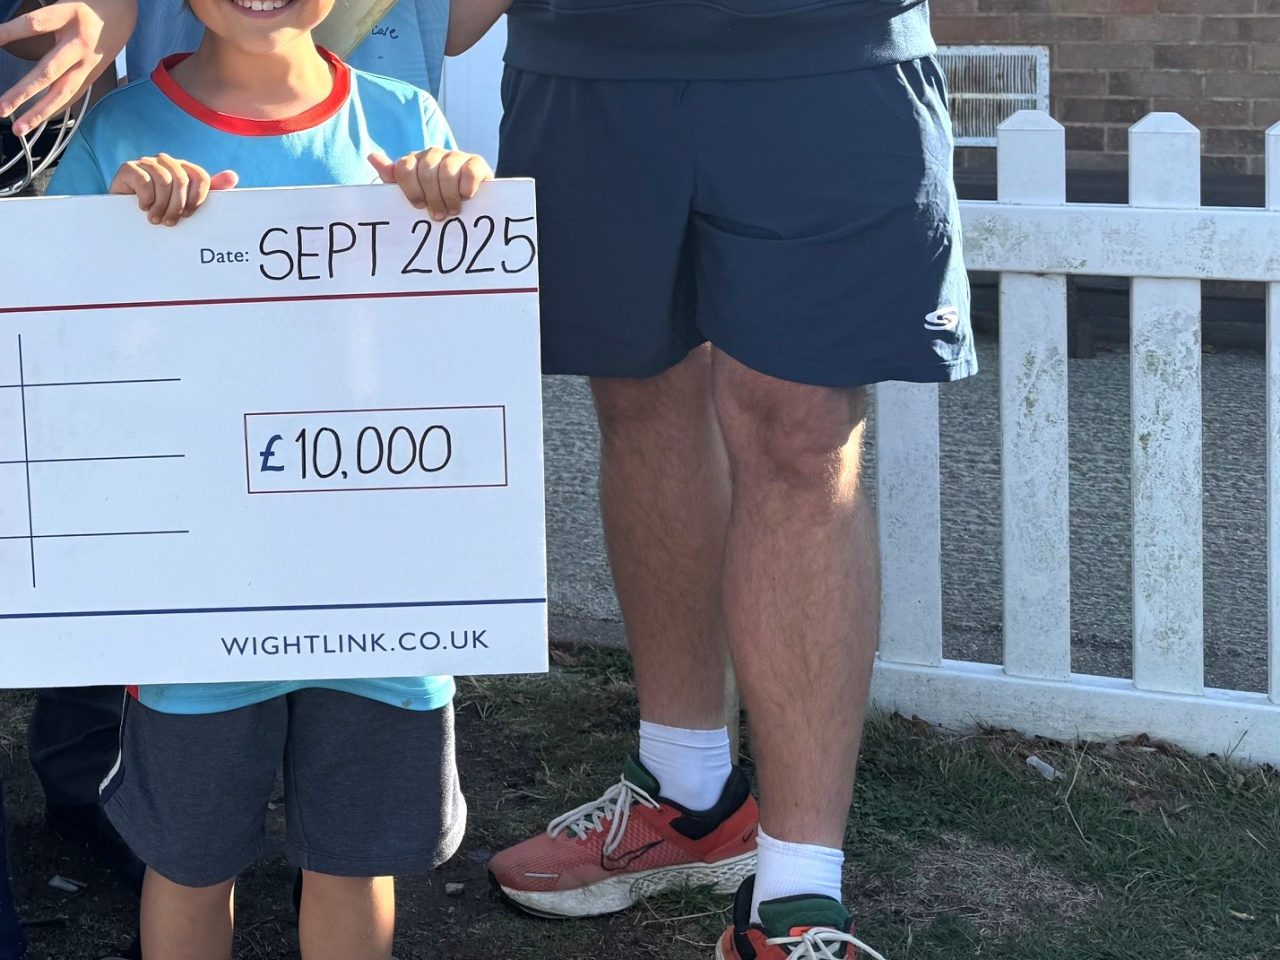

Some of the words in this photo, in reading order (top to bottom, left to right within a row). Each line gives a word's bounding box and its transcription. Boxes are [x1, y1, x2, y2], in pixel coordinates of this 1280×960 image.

[200, 247, 250, 265] Date:
[258, 221, 389, 281] SEPT
[401, 215, 537, 276] 2025
[221, 629, 490, 657] WIGHTLINK.CO.UK
